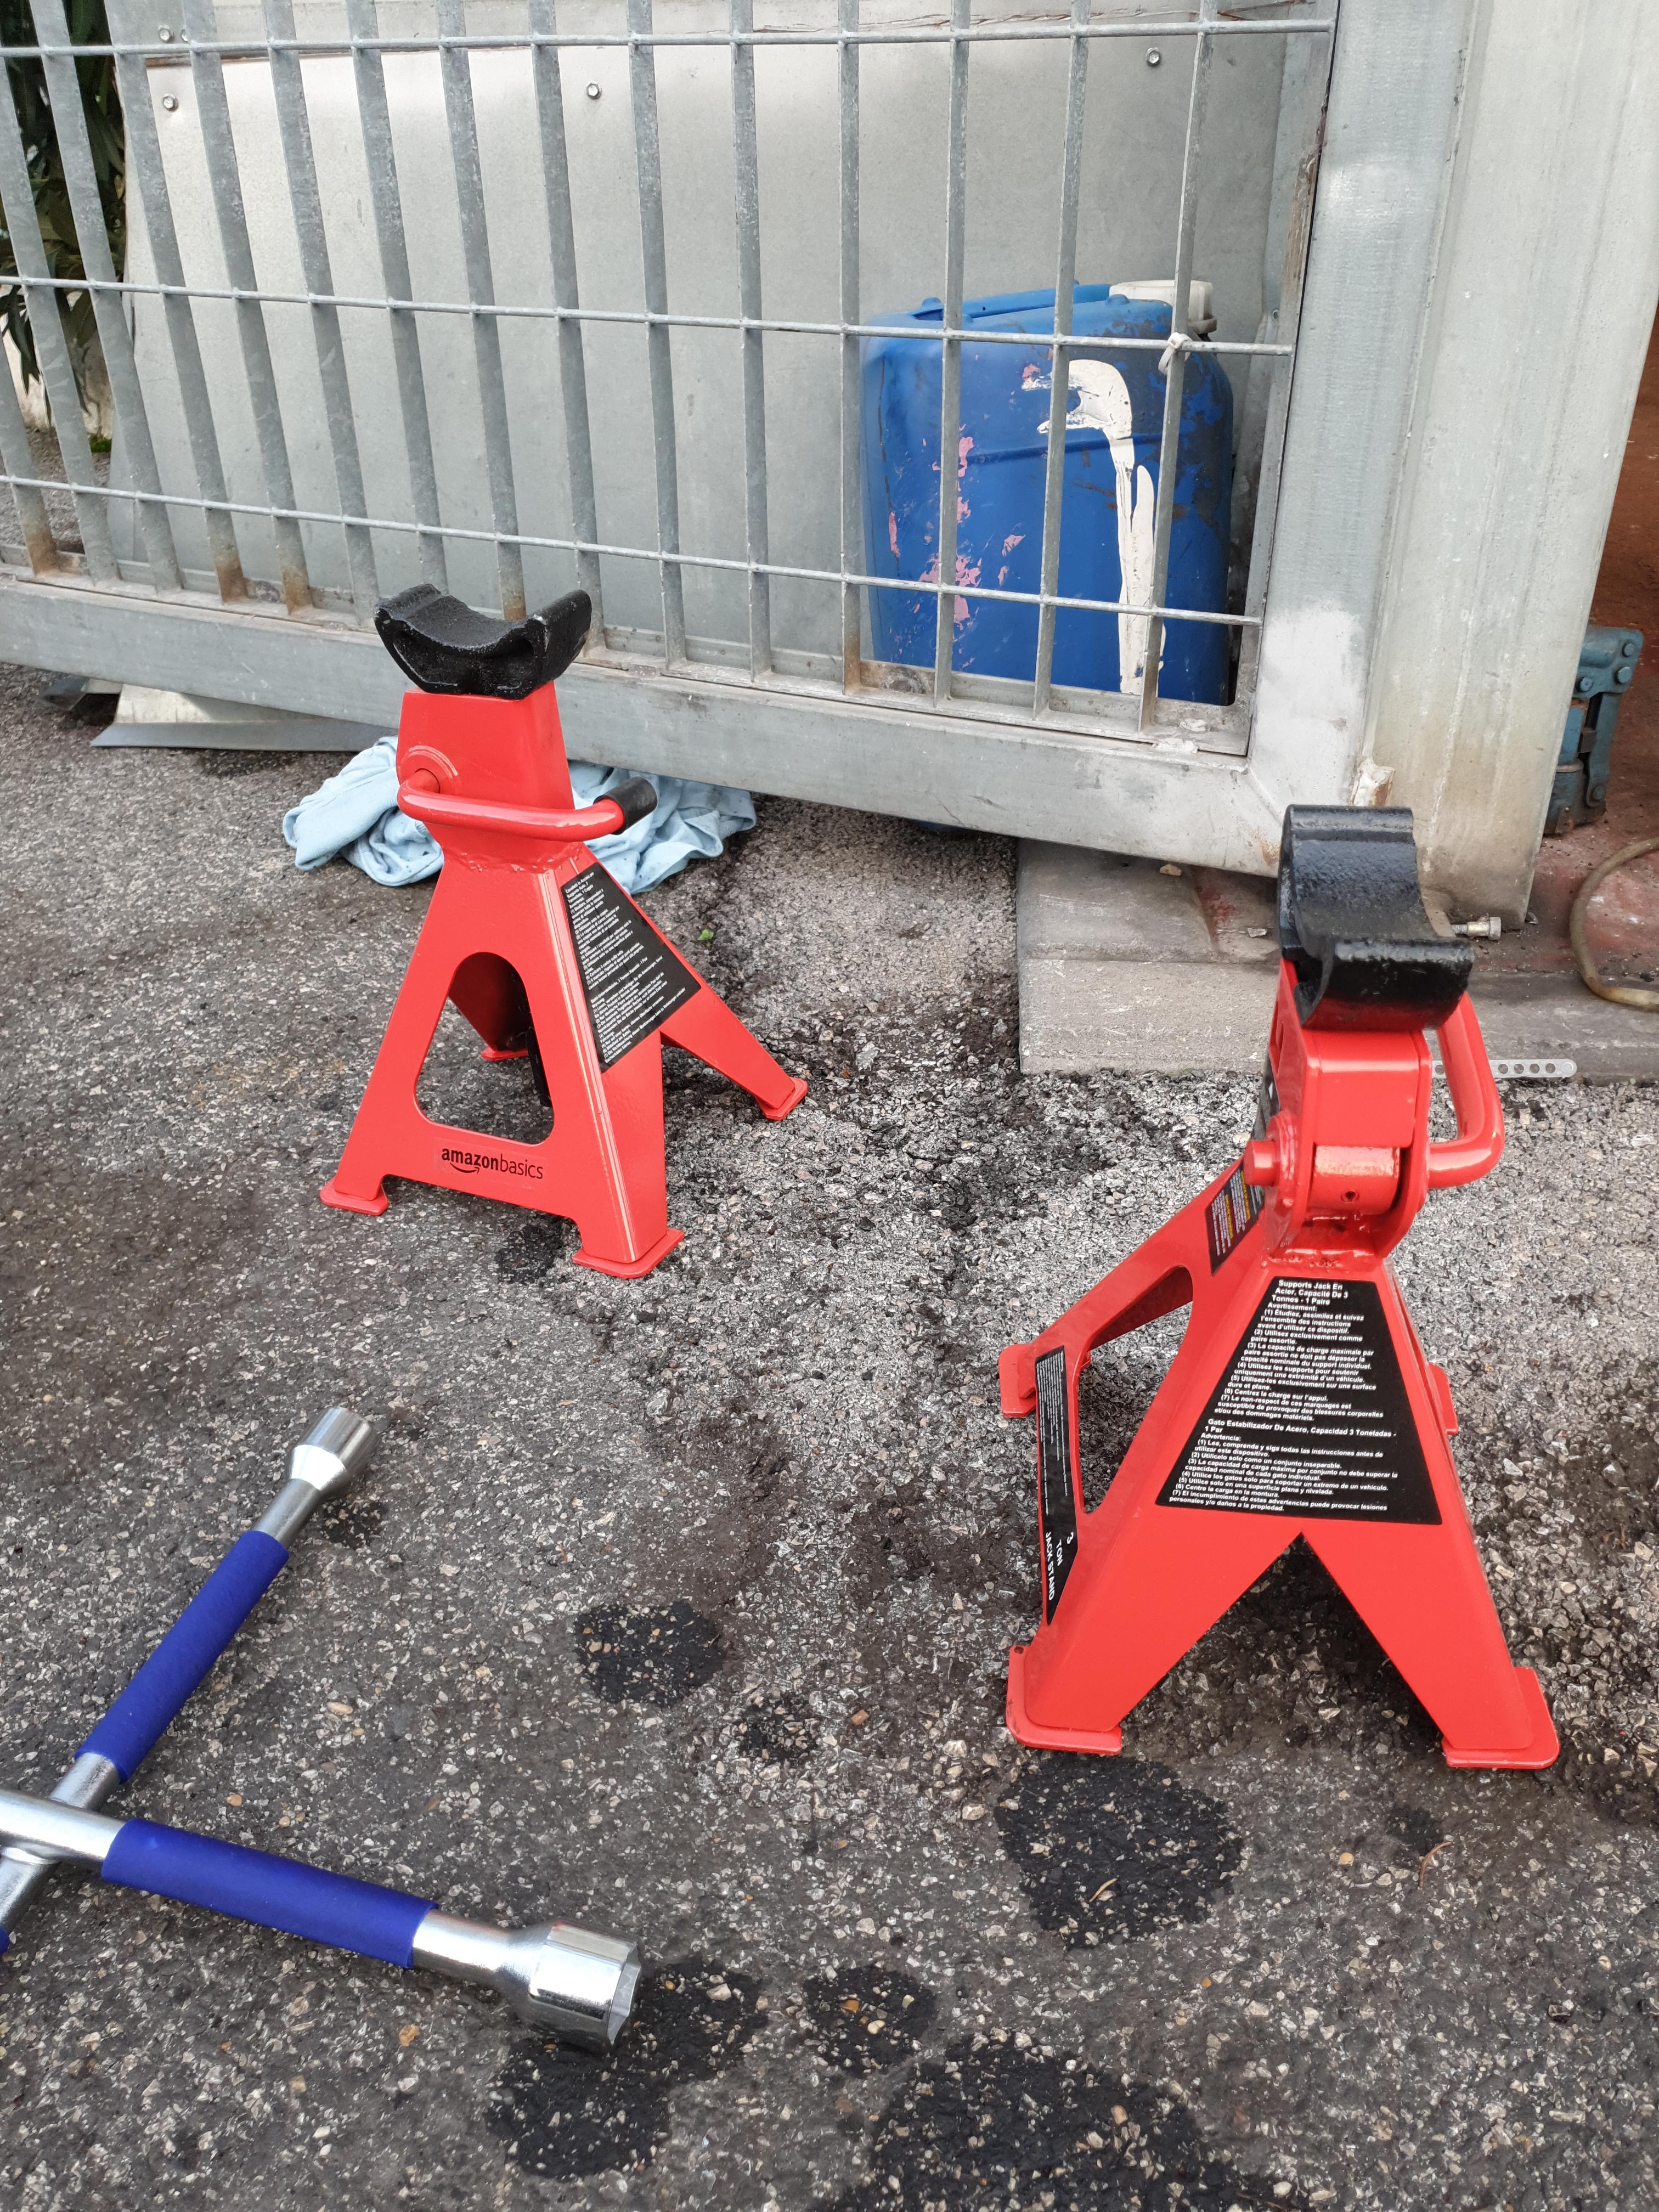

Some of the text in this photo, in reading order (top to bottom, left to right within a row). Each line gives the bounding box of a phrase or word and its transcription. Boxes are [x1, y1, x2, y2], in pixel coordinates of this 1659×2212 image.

[442, 1148, 543, 1179] amazonbasics
[1278, 1280, 1312, 1289] Supports
[1267, 1302, 1317, 1311] Avertissement:
[1289, 1331, 1338, 1340] exclusivement
[1316, 1327, 1349, 1335] dispositif.
[1233, 1368, 1273, 1377] uniquement
[1284, 1365, 1314, 1374] supports
[1240, 1396, 1280, 1404] non-respect
[1217, 1401, 1256, 1409] susceptible
[1346, 1410, 1384, 1418] corporelles
[1245, 1410, 1282, 1419] dommages
[1226, 1421, 1273, 1429] Estabilizador
[1310, 1427, 1348, 1435] Capacidad
[1200, 1432, 1240, 1441] Advertencia:
[1221, 1441, 1260, 1450] comprenda
[1232, 1449, 1270, 1458] dispositivo.
[1184, 1464, 1218, 1473] capacidad
[1206, 1460, 1241, 1468] capacidad
[1309, 1468, 1339, 1476] conjunto
[1273, 1459, 1302, 1467] conjunto
[1302, 1461, 1342, 1470] inseparable.
[1247, 1483, 1280, 1492] superficie
[1274, 1479, 1302, 1487] soportar
[1189, 1491, 1239, 1501] incumplimiento
[1168, 1496, 1205, 1505] personales
[1249, 1503, 1285, 1512] propiedad.
[1066, 1532, 1074, 1544] 3
